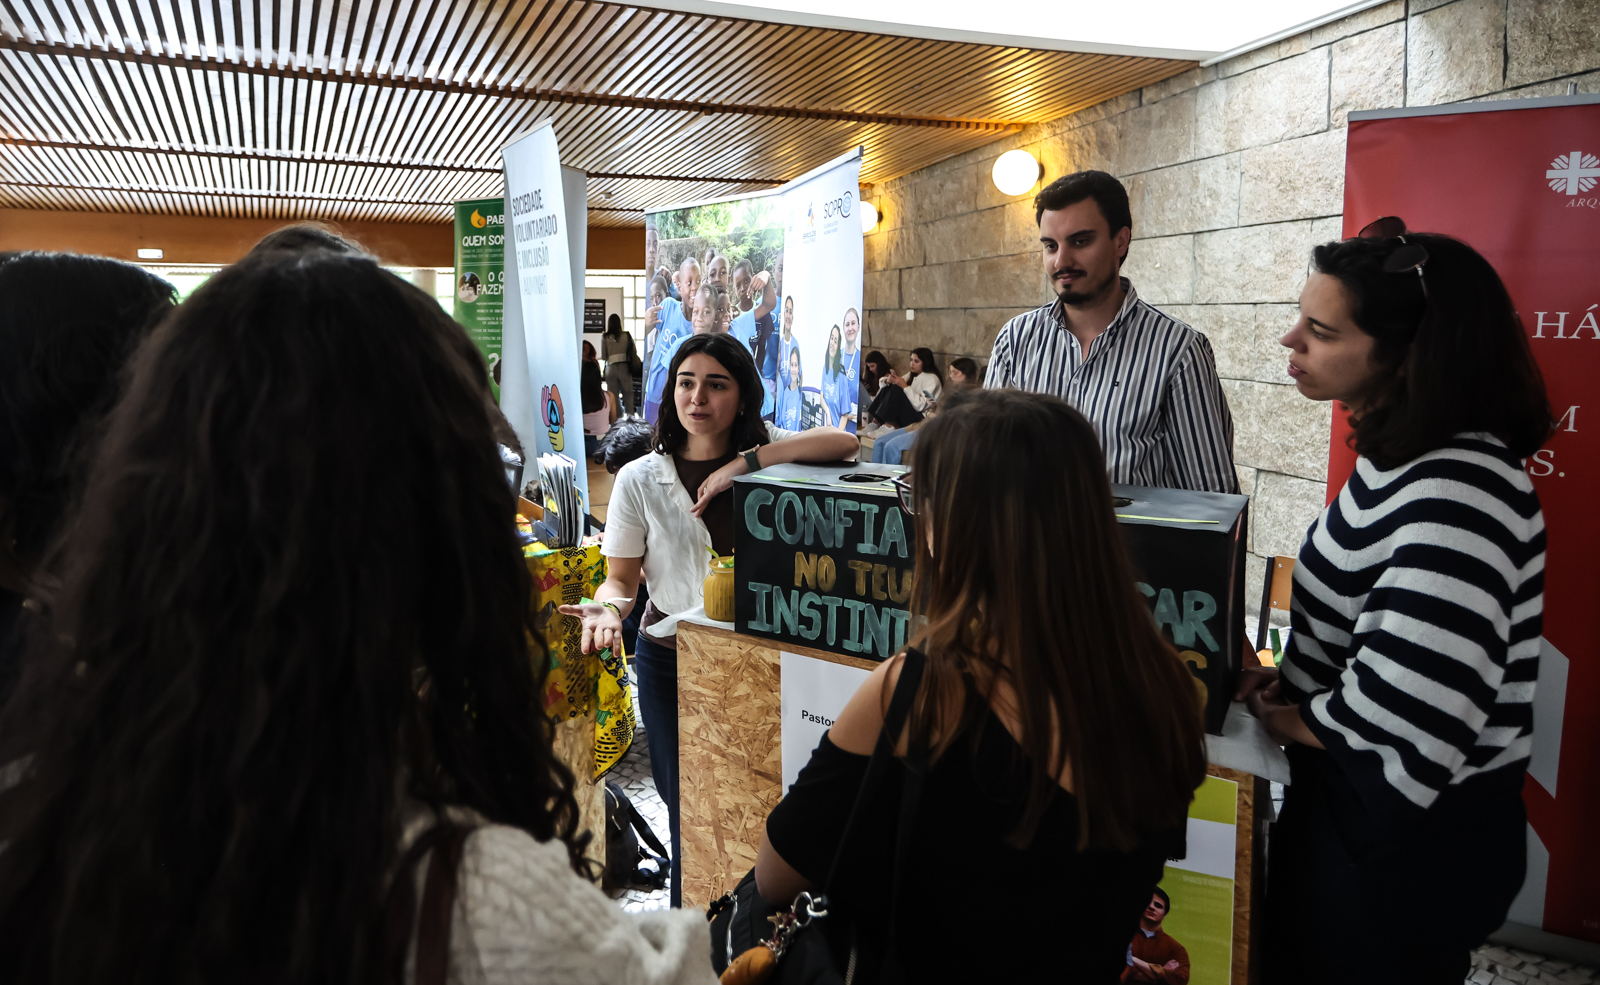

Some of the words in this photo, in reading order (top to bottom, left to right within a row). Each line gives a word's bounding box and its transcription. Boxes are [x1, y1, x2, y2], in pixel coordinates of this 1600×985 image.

[1565, 197, 1600, 209] ARQ
[462, 235, 487, 247] QUEM
[514, 214, 558, 243] VOLUNTARIADO
[488, 271, 495, 282] O
[1521, 449, 1565, 477] S.
[744, 488, 909, 558] CONFIA
[794, 551, 836, 593] NO
[848, 560, 912, 604] TEU
